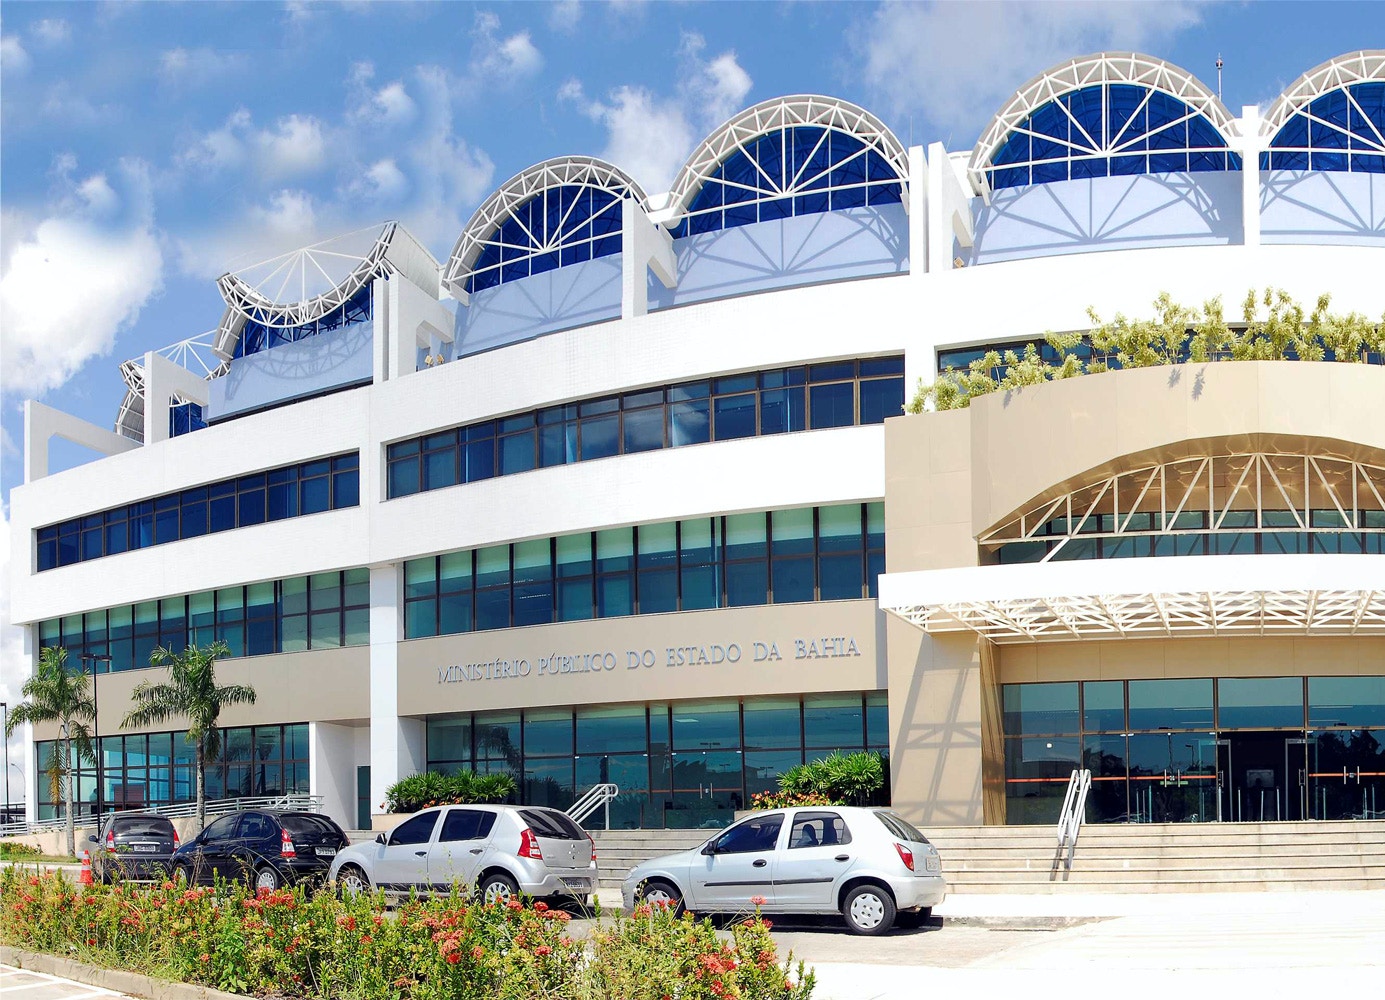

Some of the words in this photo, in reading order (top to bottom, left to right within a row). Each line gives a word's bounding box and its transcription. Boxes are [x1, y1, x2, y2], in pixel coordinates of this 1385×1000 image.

[438, 658, 531, 684] MINISTÉRIO
[538, 653, 617, 676] PÚBLICO
[626, 650, 656, 670] DO
[666, 643, 742, 667] ESTADO
[753, 641, 783, 662] DA
[795, 636, 861, 660] BAHIA
